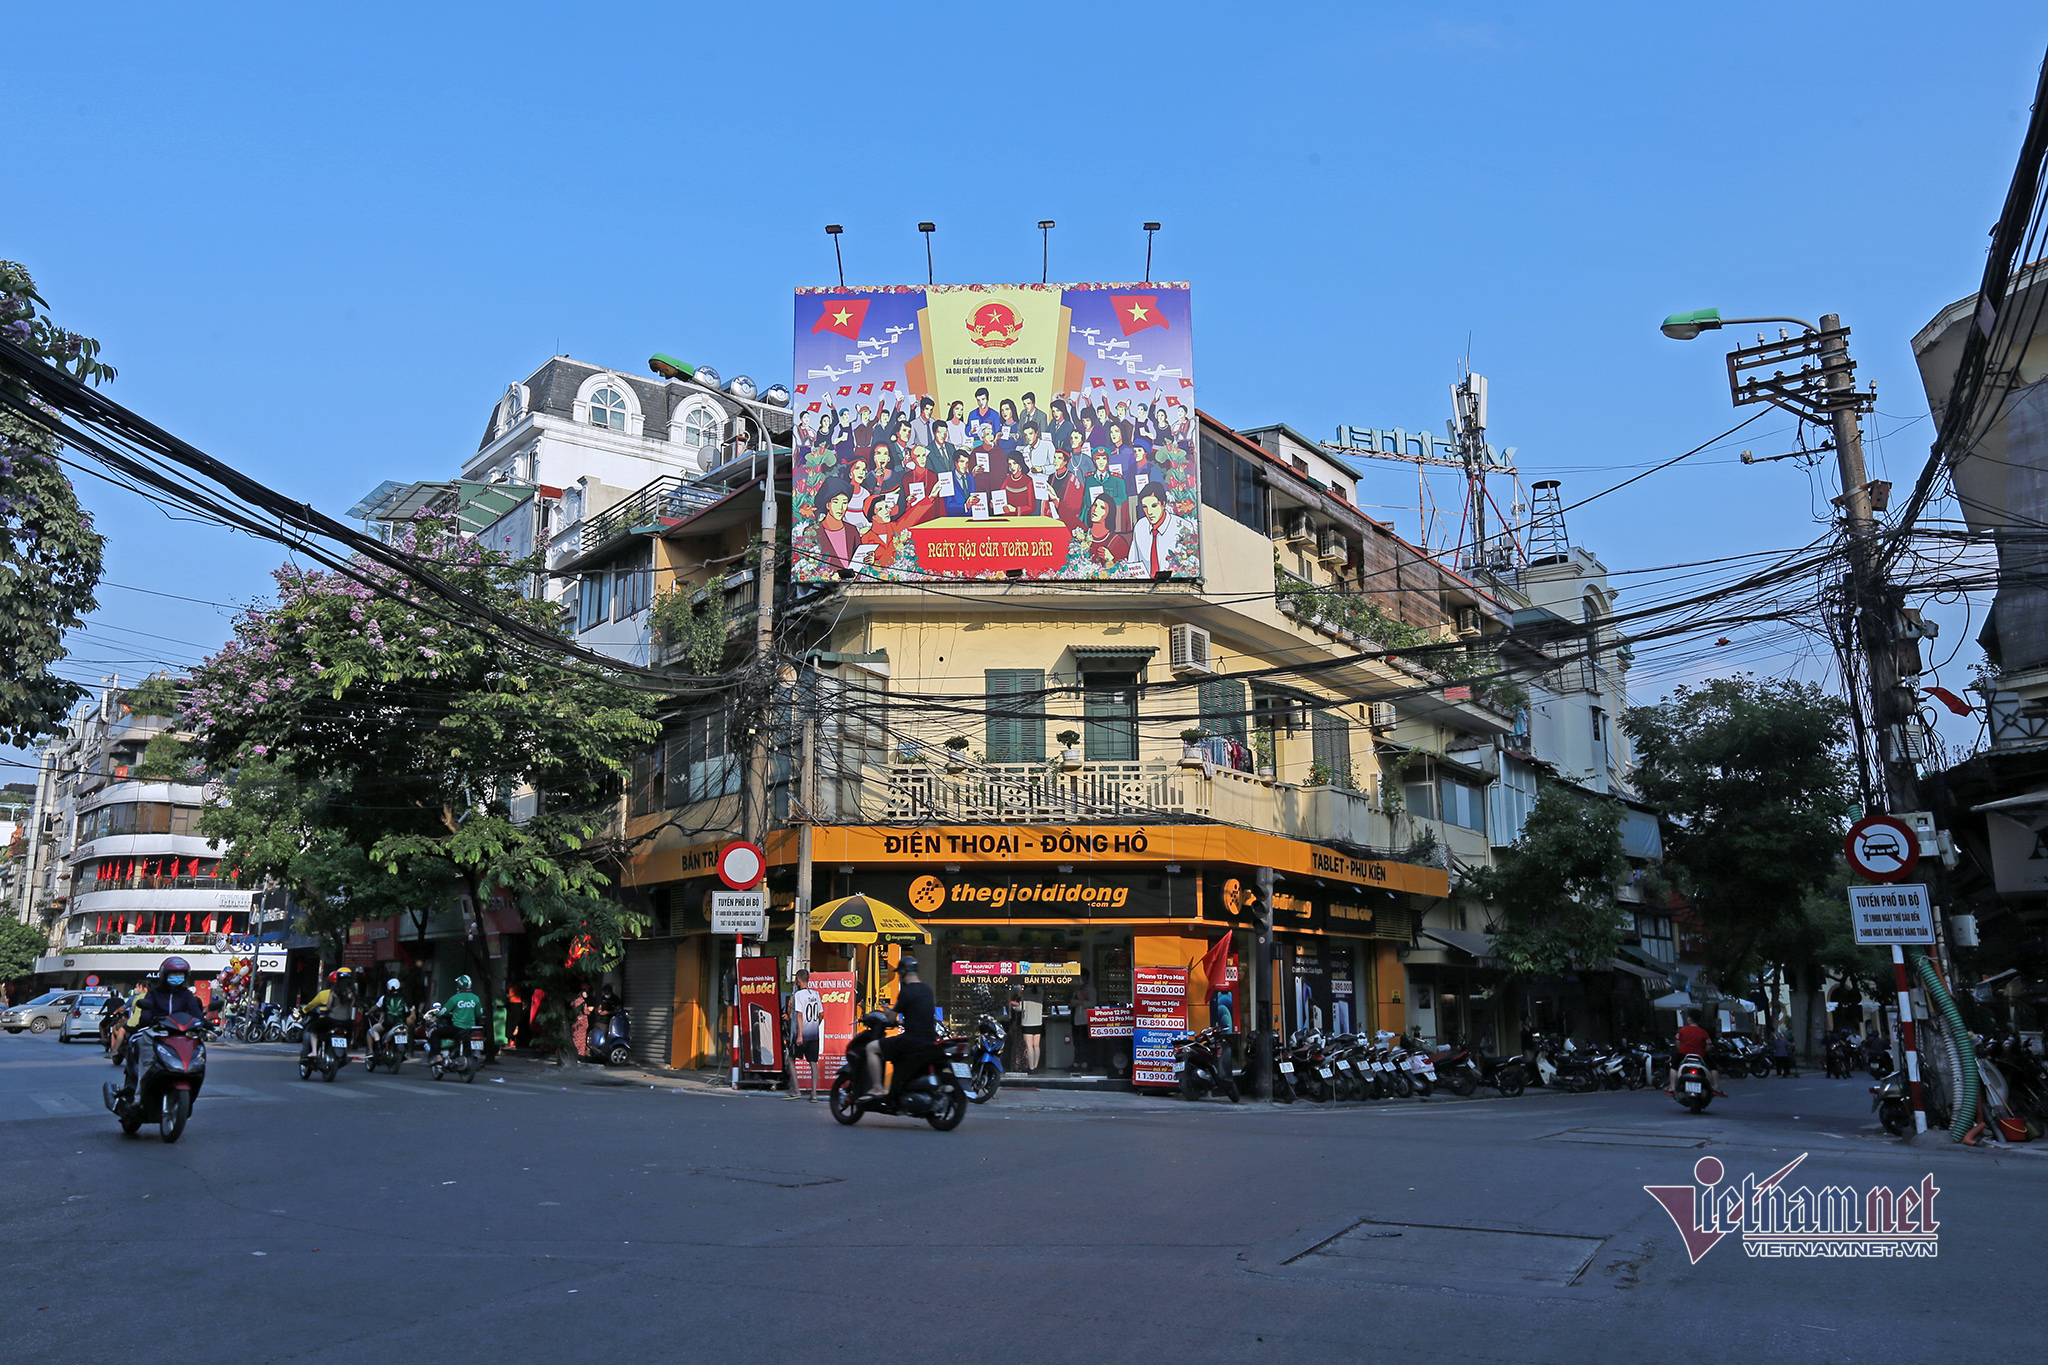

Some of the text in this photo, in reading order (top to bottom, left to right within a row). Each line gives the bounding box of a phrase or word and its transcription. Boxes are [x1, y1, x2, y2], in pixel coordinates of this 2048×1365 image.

[928, 536, 1053, 560] NGÀY HỘI CỦA TOÀN DÂN
[884, 831, 940, 858] ĐIỆN
[946, 835, 1018, 858] THOẠI
[1040, 828, 1108, 853] ĐỒNG
[1114, 827, 1148, 853] HỒ
[682, 851, 700, 871] BÁN
[1312, 853, 1344, 874] TABLET
[1350, 861, 1367, 882] PHỤ
[1369, 863, 1386, 885] KIỆN
[951, 884, 1128, 907] thegioididong
[1856, 891, 1919, 908] TUYẾN PHỐ ĐI BỘ
[808, 980, 819, 988] ONE
[819, 978, 836, 988] CHÍNH
[960, 975, 975, 983] BÁN
[993, 975, 1008, 983] GÓP
[741, 982, 776, 994] GIÁ SỐC!
[1137, 986, 1185, 994] 29.490.000
[457, 1000, 476, 1008] Grab
[806, 1002, 819, 1022] 00
[1142, 1036, 1165, 1044] Galaxy
